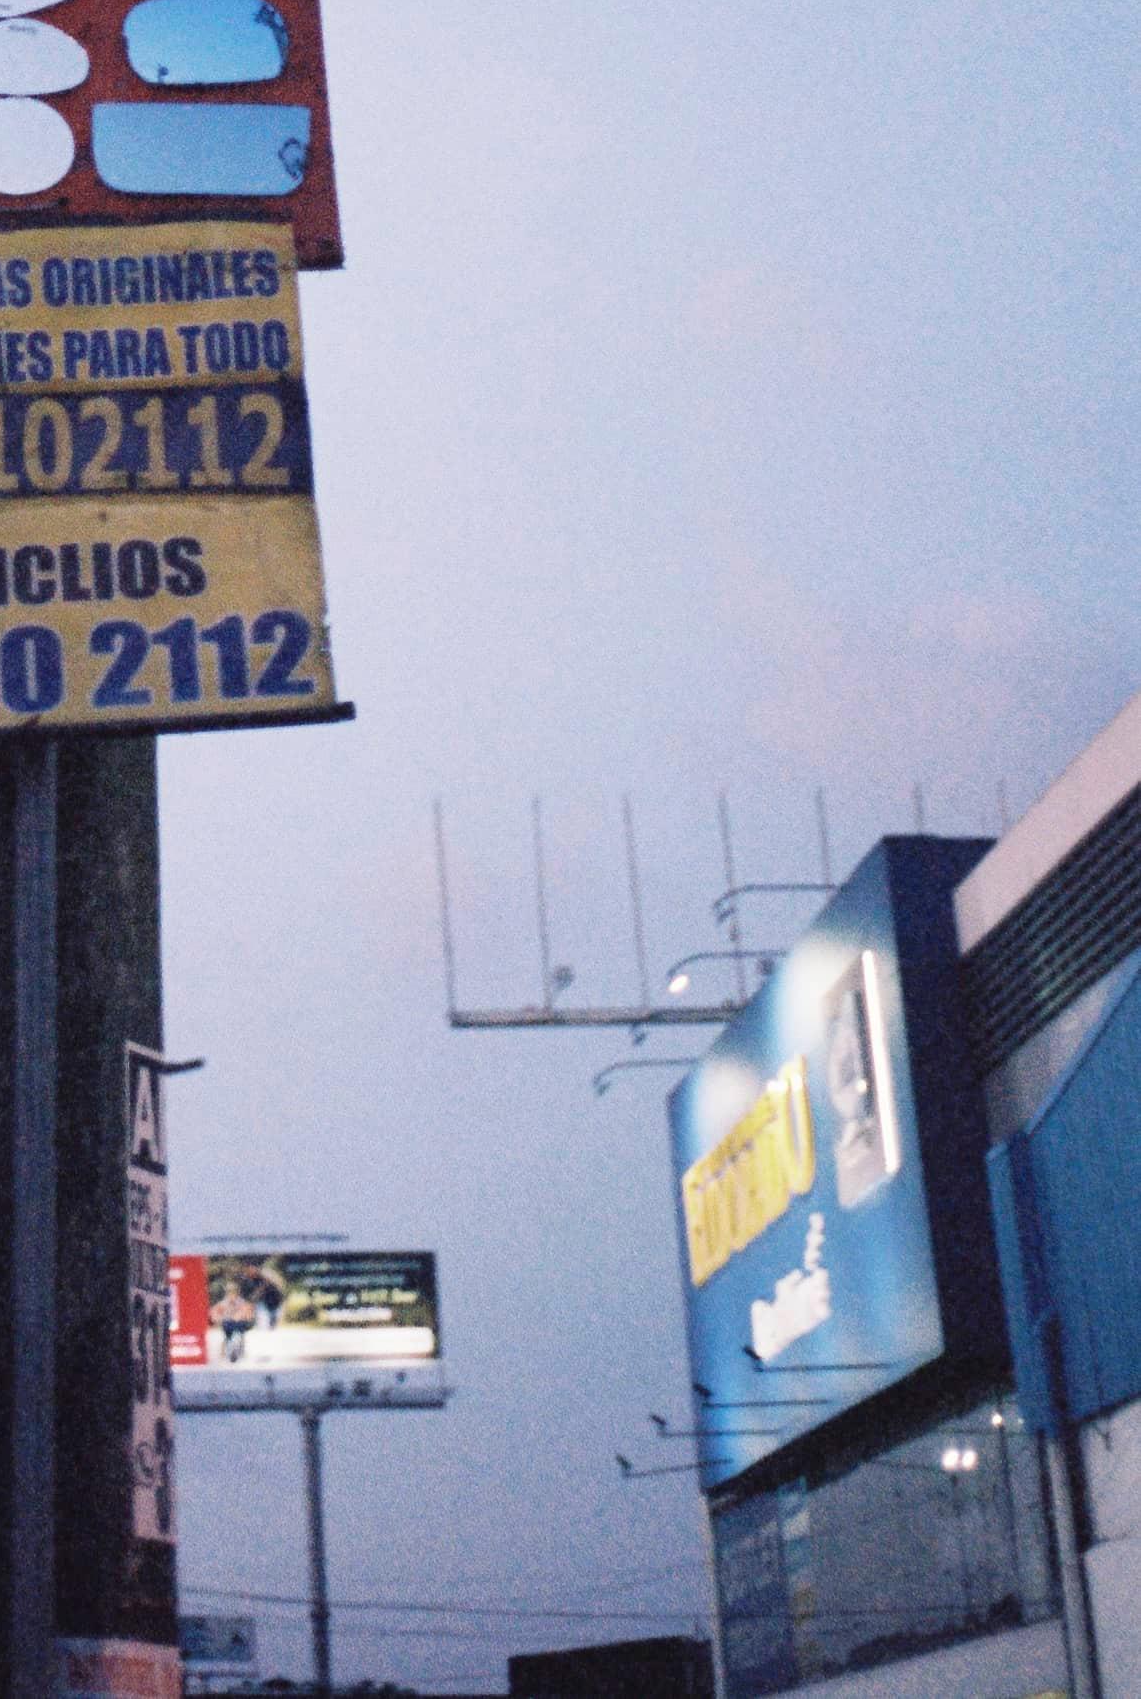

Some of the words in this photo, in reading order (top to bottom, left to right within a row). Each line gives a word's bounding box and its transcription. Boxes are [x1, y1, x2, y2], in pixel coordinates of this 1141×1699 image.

[42, 249, 281, 306] ORIGINALES
[63, 327, 172, 380] PARA
[177, 318, 291, 374] TODO
[89, 609, 316, 708] 2112
